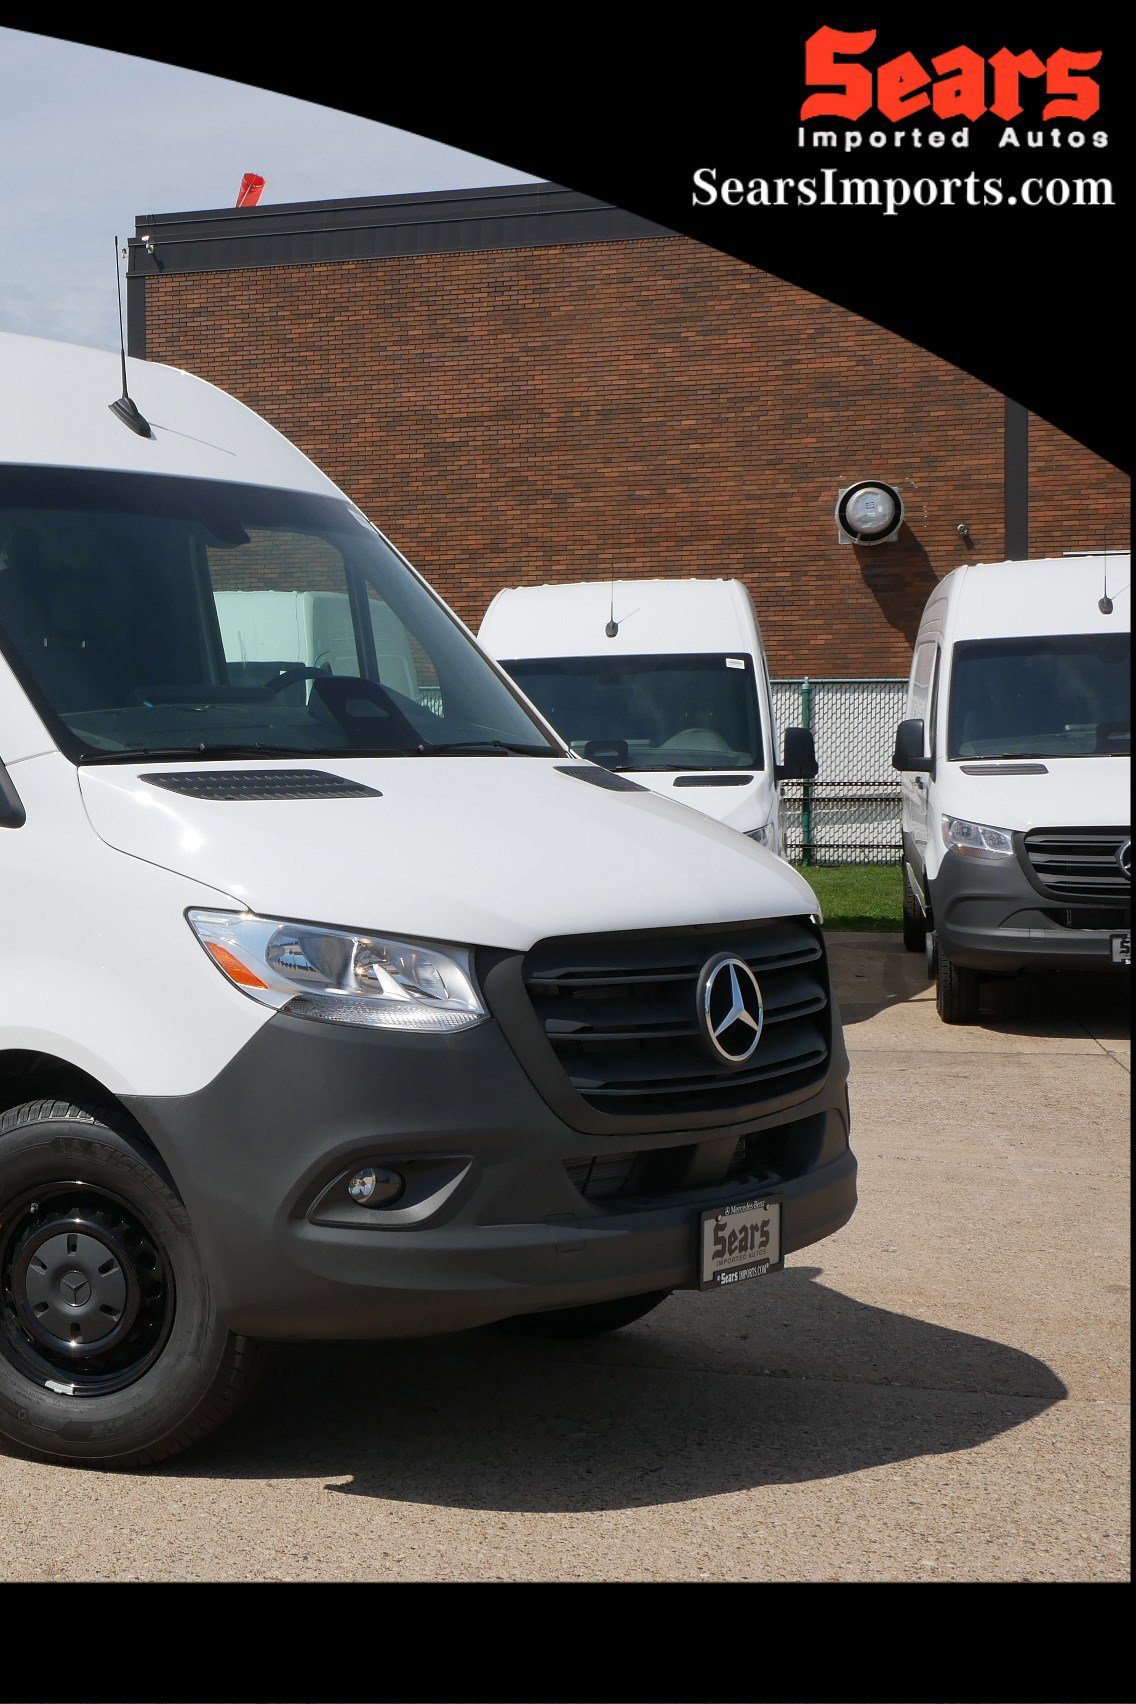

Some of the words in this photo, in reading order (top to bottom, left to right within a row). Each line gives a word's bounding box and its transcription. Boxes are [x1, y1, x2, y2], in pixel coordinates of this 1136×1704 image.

[712, 1218, 770, 1261] Sears
[716, 1254, 747, 1267] IMPORTED
[748, 1248, 767, 1259] AUTOS
